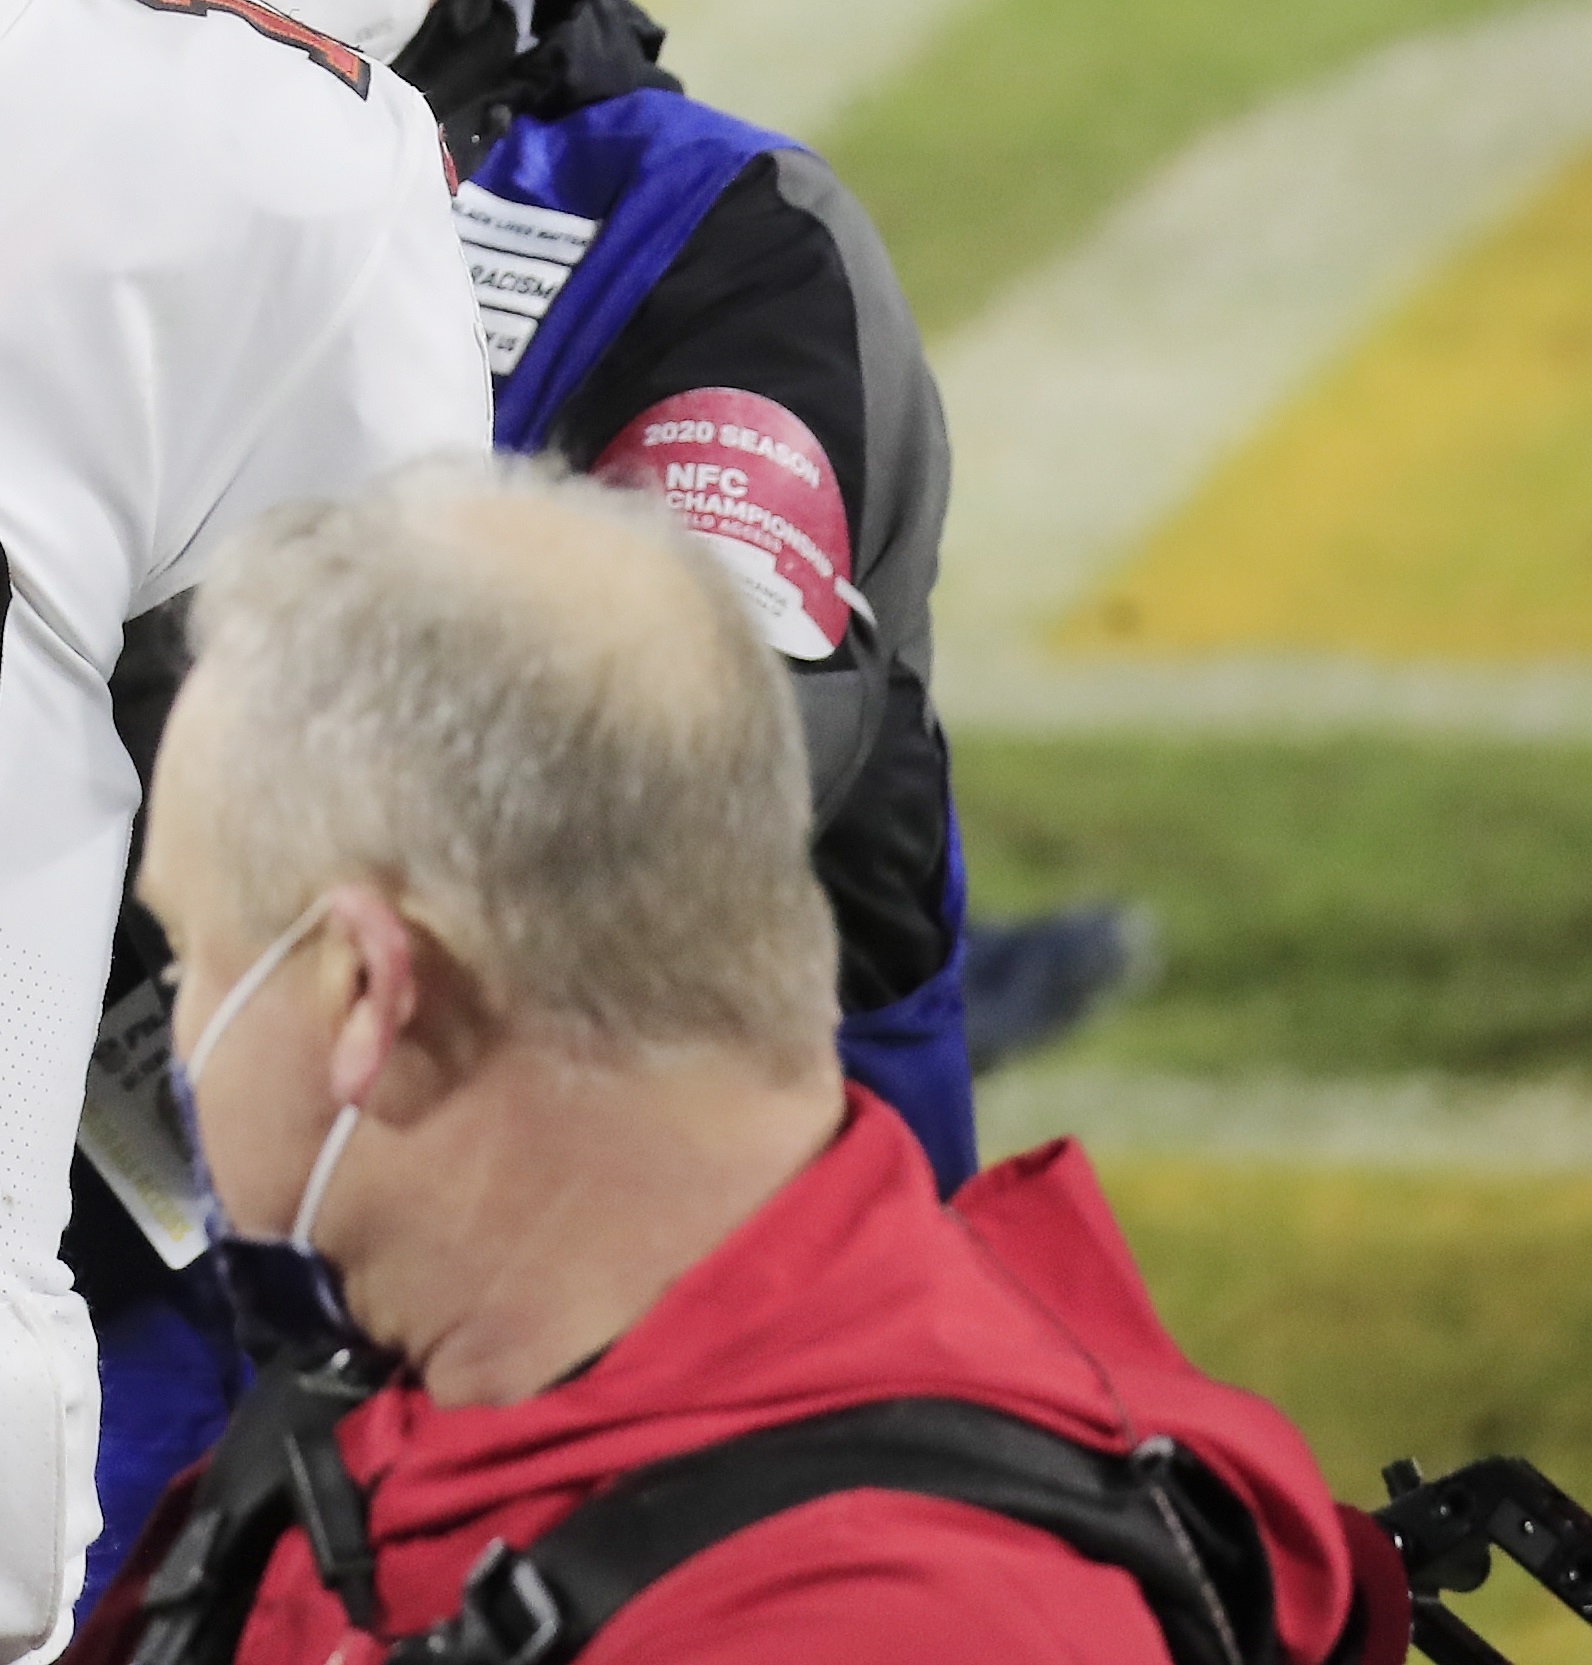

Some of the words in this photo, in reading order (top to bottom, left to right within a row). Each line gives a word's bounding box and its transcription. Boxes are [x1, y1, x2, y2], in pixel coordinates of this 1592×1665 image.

[642, 419, 716, 448] 2020
[718, 423, 821, 490] SEASON
[666, 461, 749, 498] NFC
